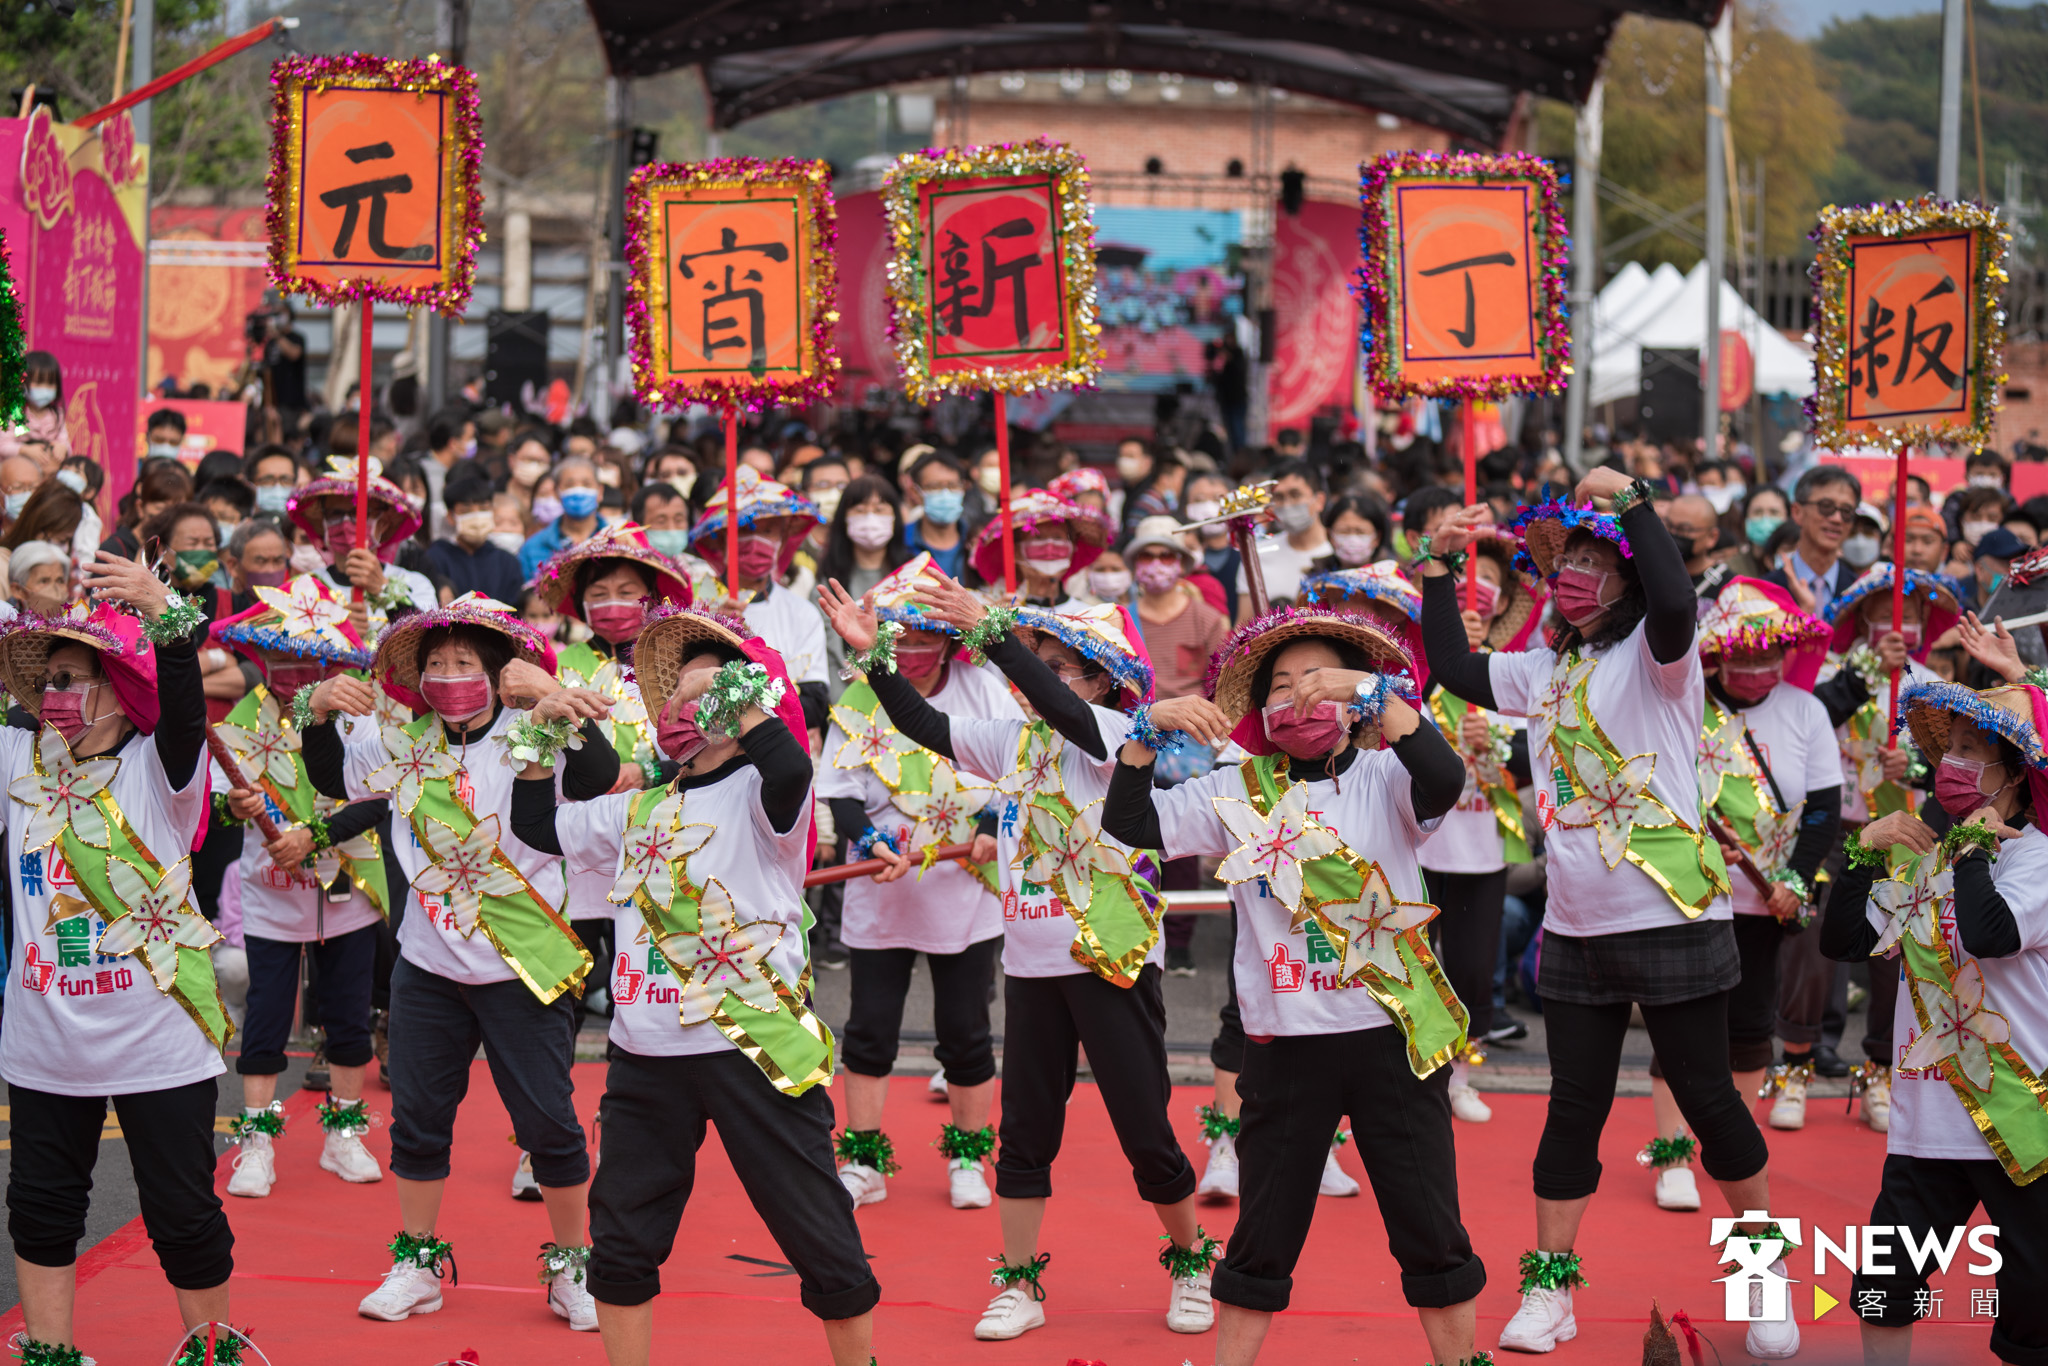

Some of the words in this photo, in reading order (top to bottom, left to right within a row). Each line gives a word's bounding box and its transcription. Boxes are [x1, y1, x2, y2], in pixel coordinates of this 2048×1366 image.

[319, 141, 435, 260] 元
[678, 227, 789, 379] 宵
[934, 217, 1042, 349] 新
[1418, 251, 1516, 348] 丁
[1851, 275, 1965, 399] 粄
[55, 916, 129, 968] 農
[1020, 897, 1066, 920] fun臺
[57, 967, 133, 996] fun臺中
[645, 982, 680, 1004] fun
